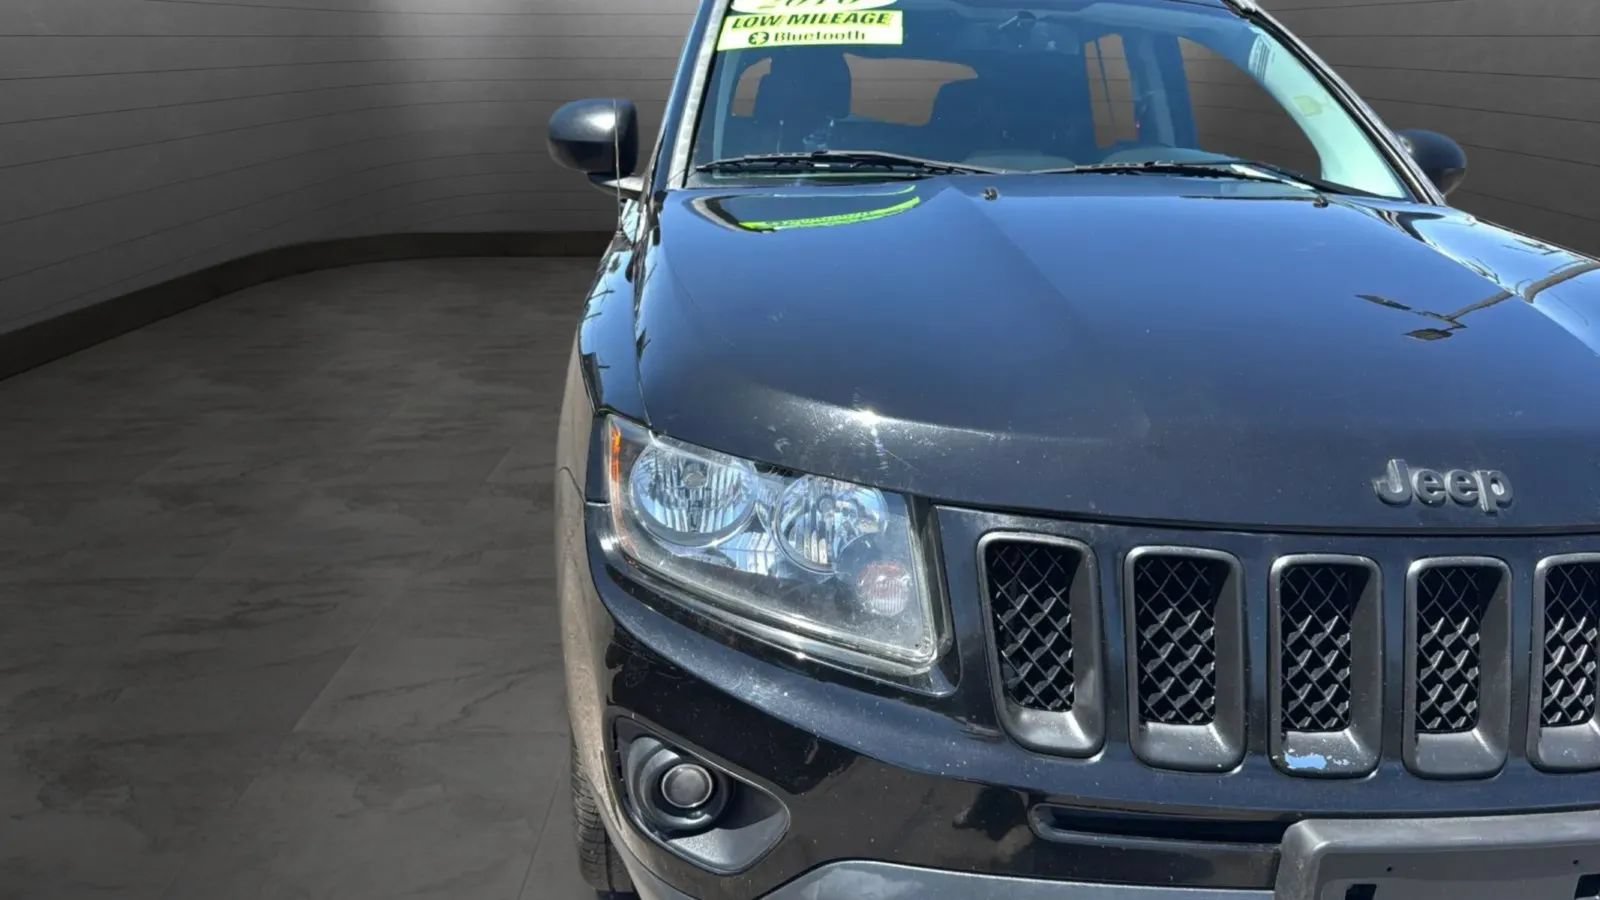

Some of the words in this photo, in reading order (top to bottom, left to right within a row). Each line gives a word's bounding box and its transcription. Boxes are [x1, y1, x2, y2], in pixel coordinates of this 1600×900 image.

[731, 14, 782, 29] LOW
[786, 12, 890, 26] MILEAGE
[774, 30, 866, 42] Bluetooth
[1372, 458, 1513, 515] Jeep
